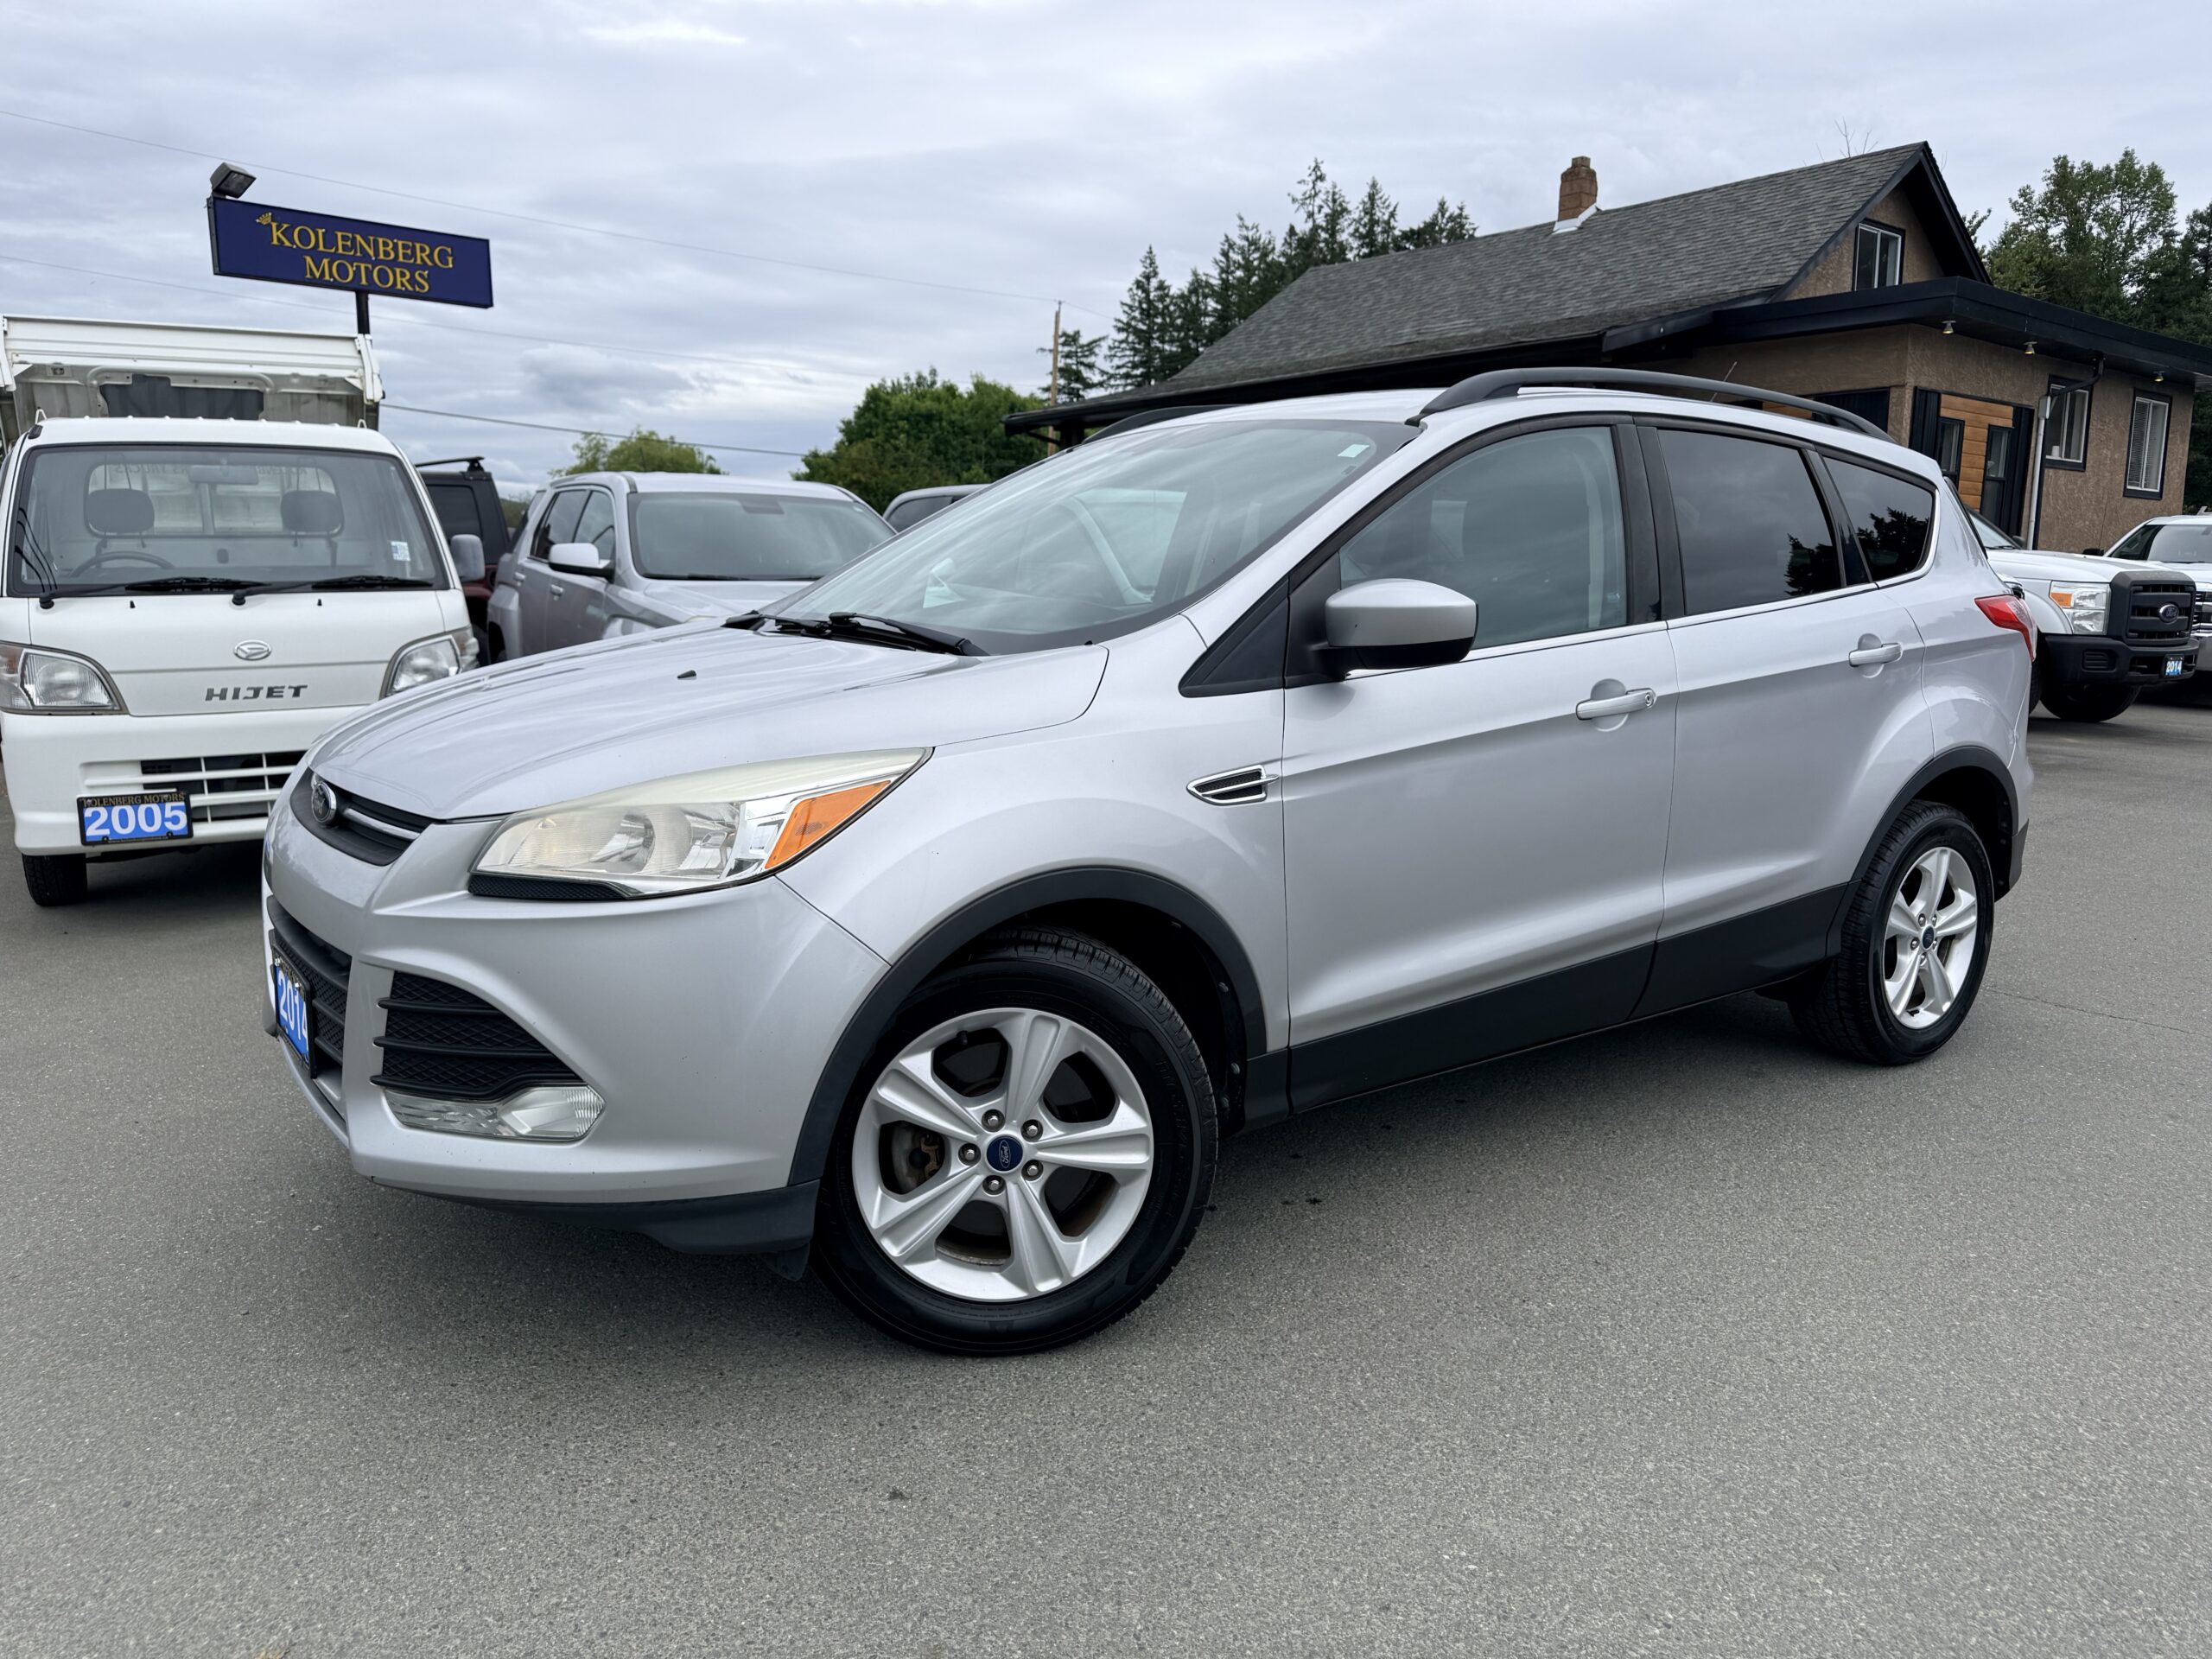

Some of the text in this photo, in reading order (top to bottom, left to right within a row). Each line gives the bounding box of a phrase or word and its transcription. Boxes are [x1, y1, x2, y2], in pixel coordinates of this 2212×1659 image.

[270, 222, 454, 269] KOLENBERG
[303, 255, 429, 293] MOTORS
[2165, 660, 2183, 673] 2014
[205, 684, 308, 701] HIJET
[144, 792, 184, 804] MOTORS
[84, 802, 188, 836] 2005
[278, 969, 309, 1053] 2014
